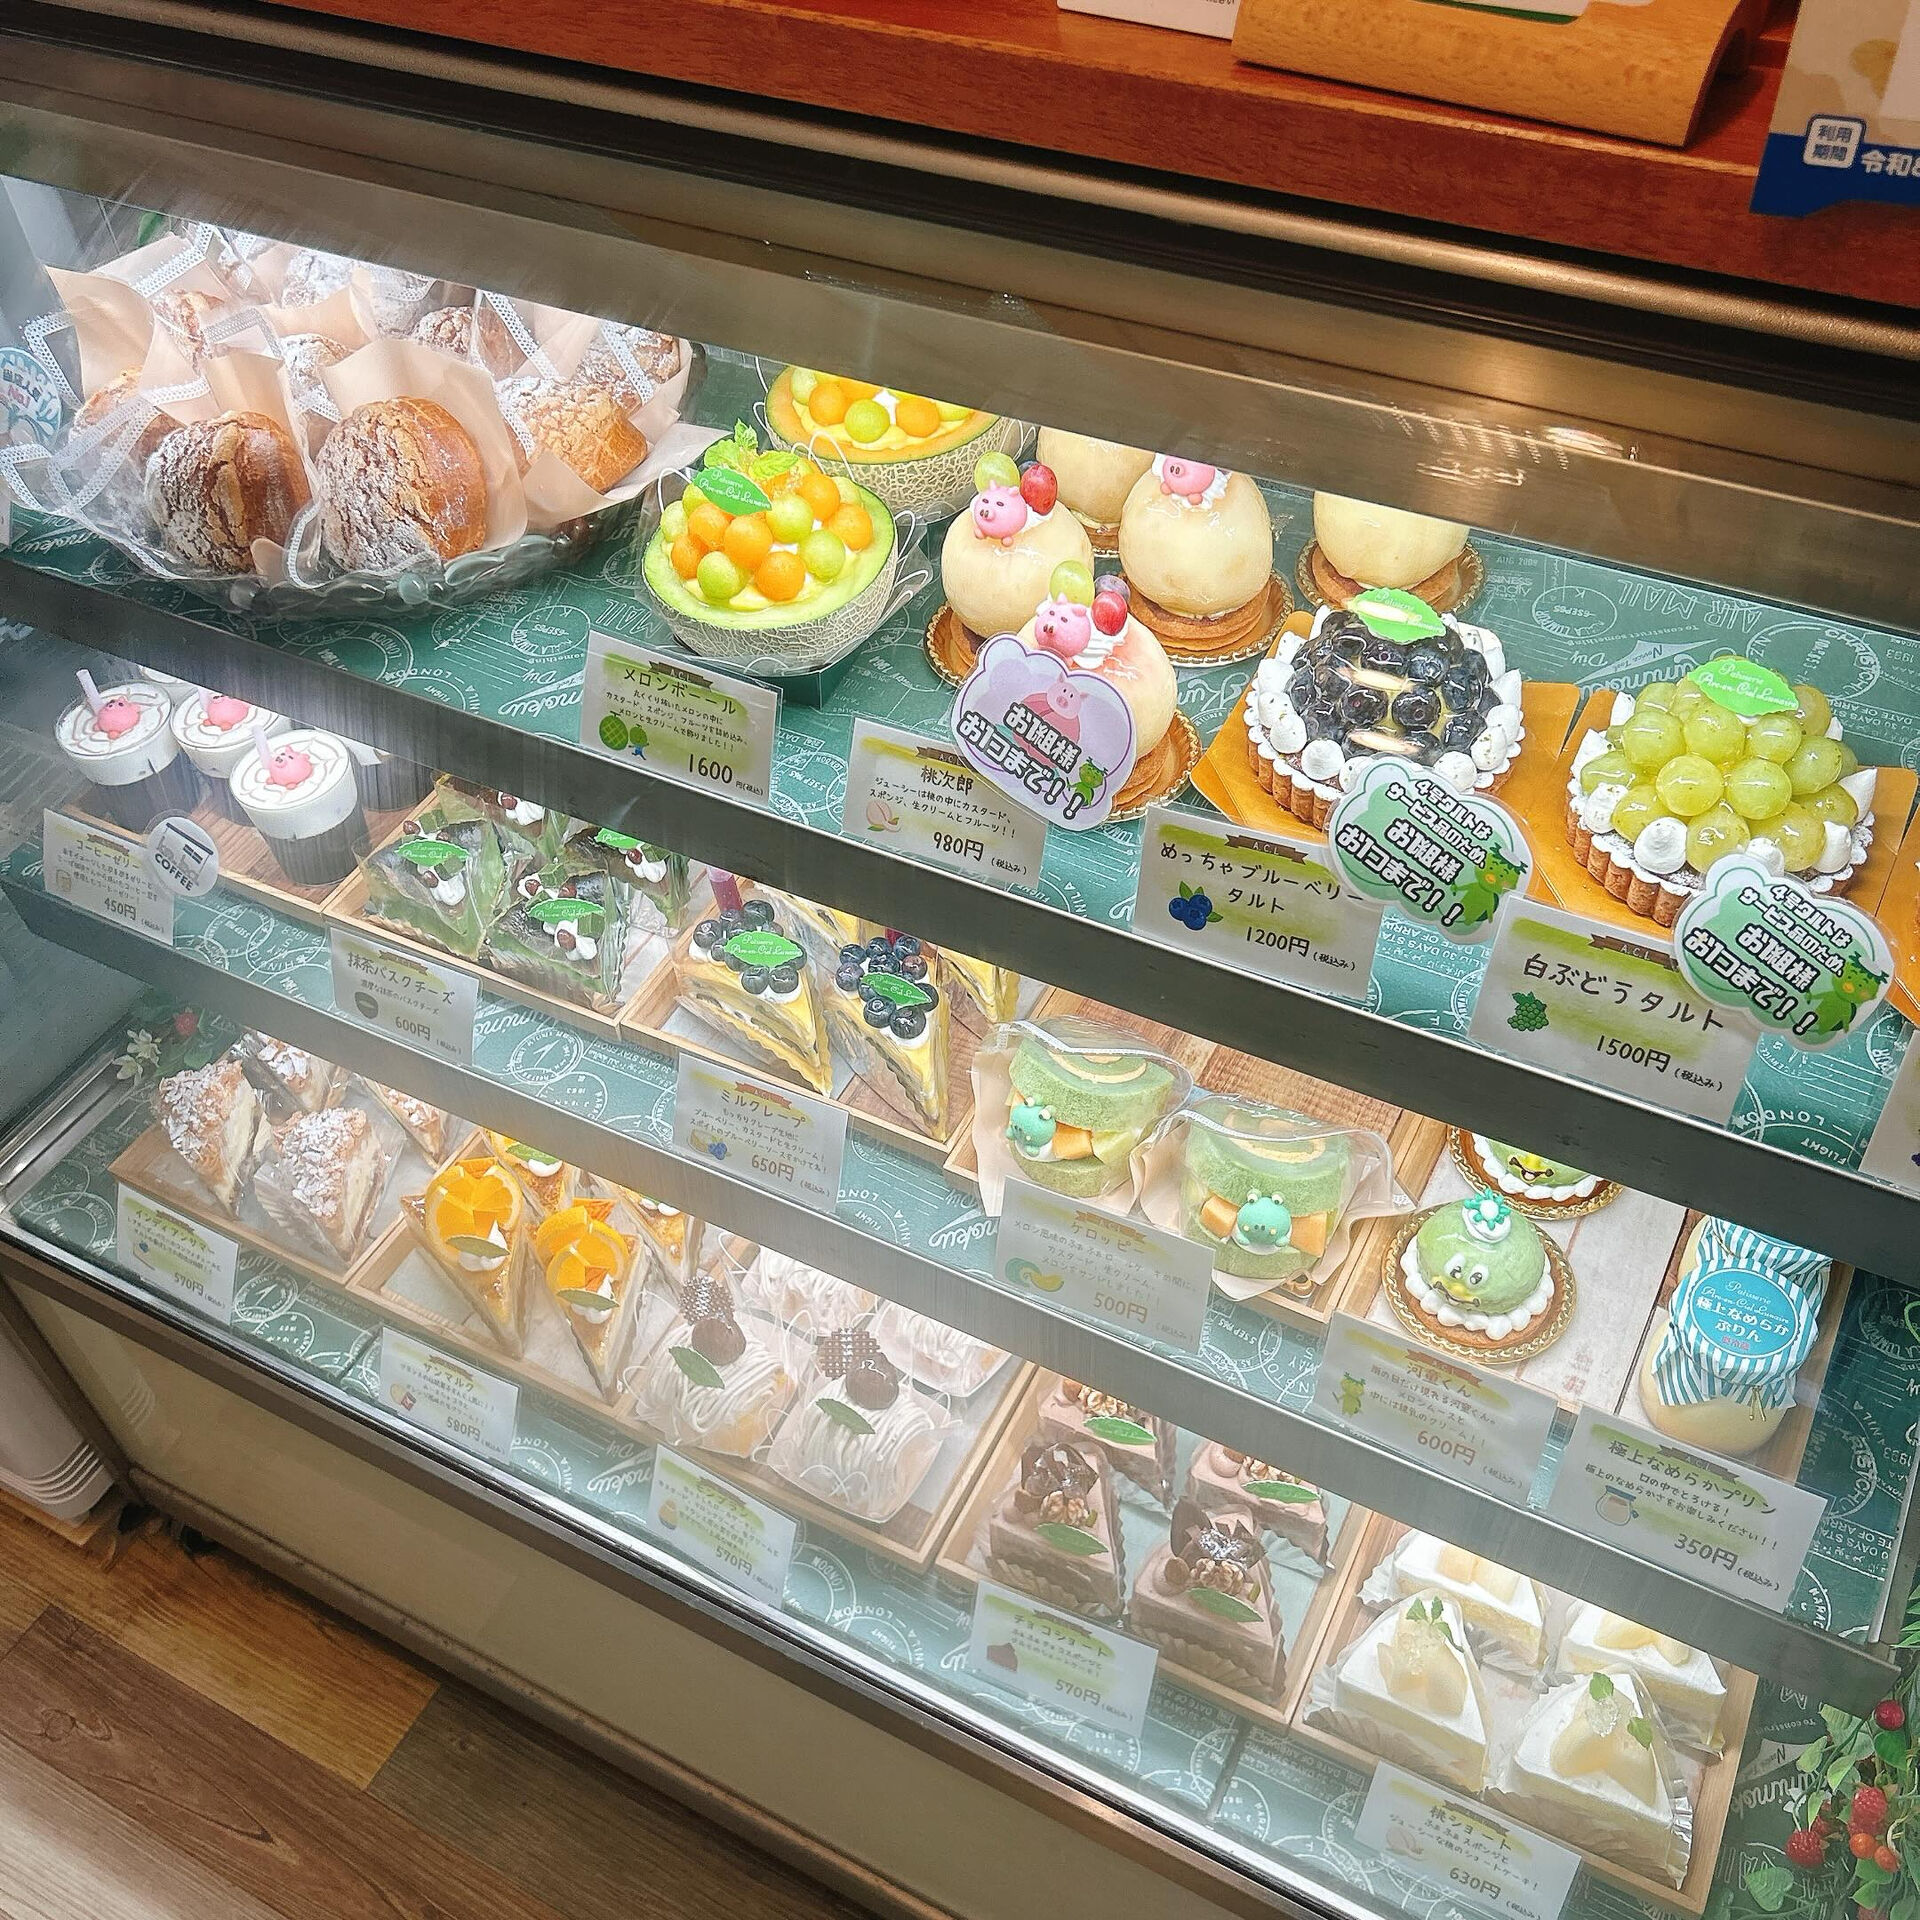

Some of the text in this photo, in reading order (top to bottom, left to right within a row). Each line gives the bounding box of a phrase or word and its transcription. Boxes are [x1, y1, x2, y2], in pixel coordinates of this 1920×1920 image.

[1818, 124, 1853, 143] 利用
[688, 753, 733, 784] 1600
[921, 765, 974, 797] 桃次郎
[1385, 782, 1487, 870] サービス品のため、
[1415, 779, 1493, 842] 4号タルトは
[154, 852, 194, 892] COFFEE
[933, 831, 1028, 876] 980円 (税込み)
[1160, 842, 1364, 902] めっちゃブルーベリー
[103, 896, 137, 922] 450円
[1227, 887, 1285, 914] タルト
[1770, 884, 1853, 948] 4号タルトは
[1246, 926, 1356, 972] 1200円 (税込み)
[1738, 886, 1845, 978] サービス品のため、
[346, 951, 456, 1006] 抹茶バスクチーズ
[1523, 953, 1724, 1032] 白ぶどうタルト
[394, 1015, 432, 1042] 600円
[1596, 1035, 1724, 1093] 1500円 (税込み)
[720, 1088, 807, 1129] ミルクレープ
[750, 1154, 795, 1184] 650円
[174, 1271, 205, 1297] 570円
[1092, 1291, 1148, 1325] 500円
[1695, 1295, 1790, 1337] 極上なめらか
[1715, 1318, 1763, 1344] ぷりん
[423, 1361, 475, 1392] サンマルク
[1406, 1362, 1472, 1399] 河童くん
[446, 1415, 481, 1442] 580円
[1416, 1430, 1477, 1467] 600円
[1607, 1438, 1777, 1516] 極上なめらかプリン
[1639, 1471, 1731, 1518] 口の中でとろける！
[714, 1545, 753, 1577] 570円
[1674, 1532, 1781, 1592] 350円 (税込み)
[1013, 1613, 1109, 1659] チョコショート
[1055, 1678, 1102, 1708] 570円
[1429, 1805, 1512, 1853] 桃ショート
[1448, 1865, 1502, 1901] 630円
